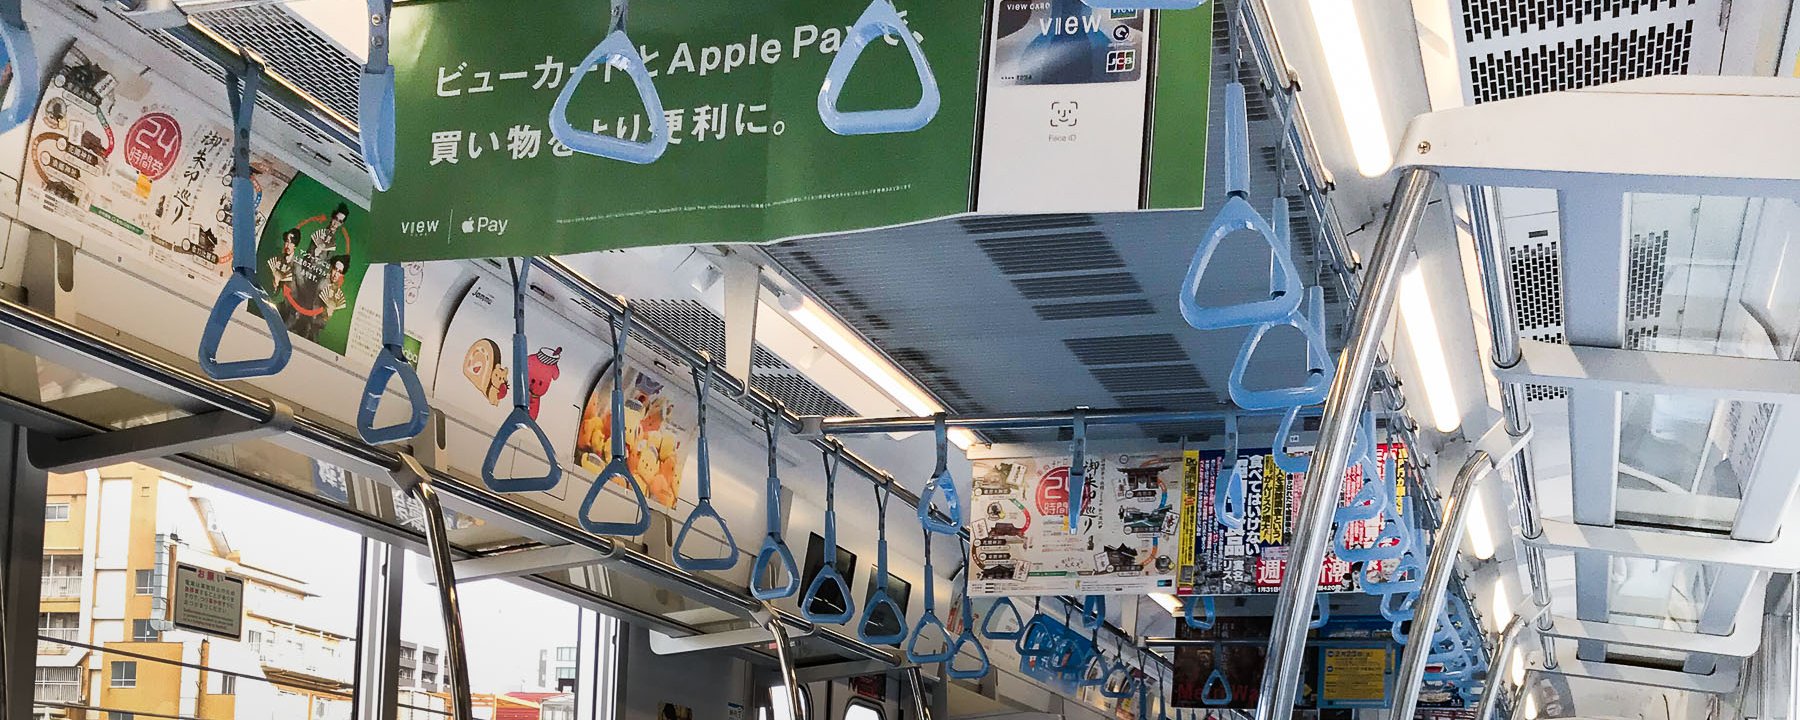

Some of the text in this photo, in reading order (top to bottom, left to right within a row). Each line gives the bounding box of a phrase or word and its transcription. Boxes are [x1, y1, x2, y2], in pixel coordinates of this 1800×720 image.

[1030, 2, 1050, 10] CARD
[437, 45, 659, 97] ビューカーと
[667, 33, 782, 76] Apple
[793, 24, 854, 58] Pa
[135, 117, 178, 159] 24
[1048, 134, 1077, 142] Face ID
[171, 129, 222, 225] 御朱印巡り
[477, 216, 509, 236] Pay
[197, 569, 224, 582] お願い
